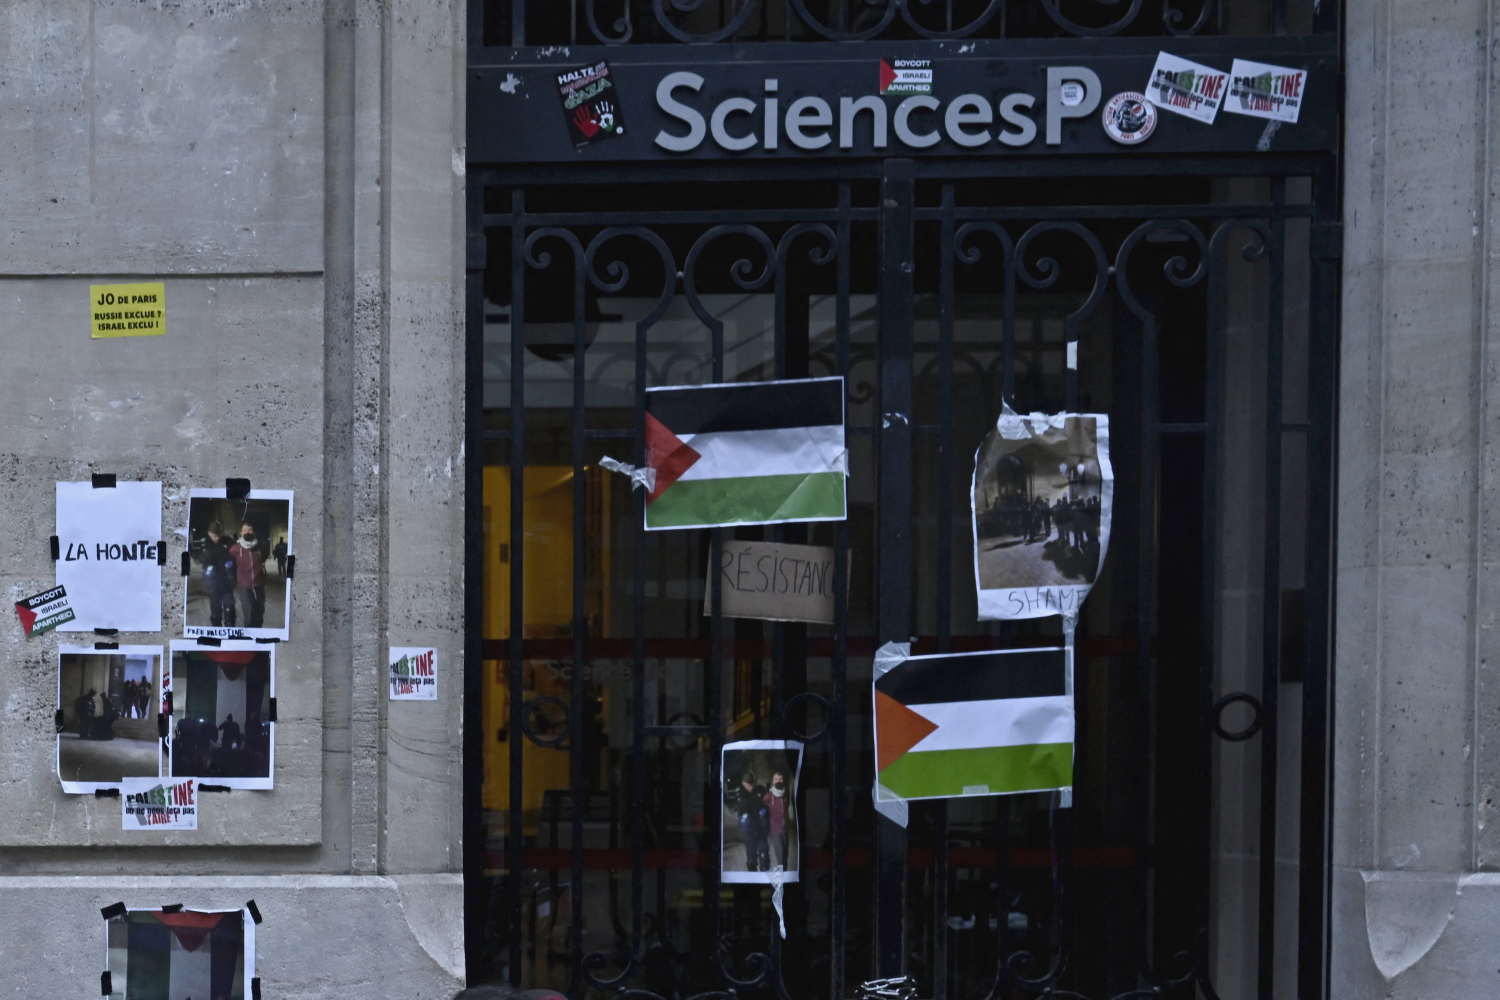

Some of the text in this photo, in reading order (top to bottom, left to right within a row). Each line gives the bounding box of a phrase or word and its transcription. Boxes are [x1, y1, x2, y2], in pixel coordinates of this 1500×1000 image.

[558, 67, 594, 84] HALTE
[98, 293, 157, 305] JO DE PARIS
[94, 310, 161, 320] RUSSIE EXCLUE ?
[98, 322, 126, 330] ISRAEL
[128, 321, 154, 329] EXCLU
[65, 540, 157, 562] LA HONTE
[29, 588, 64, 606] BOYCOTT
[41, 599, 68, 614] ISRAELI
[32, 610, 73, 632] APARTHEID
[206, 628, 244, 636] PALESTINE
[126, 779, 194, 806] PALESTINE
[183, 808, 195, 816] pas
